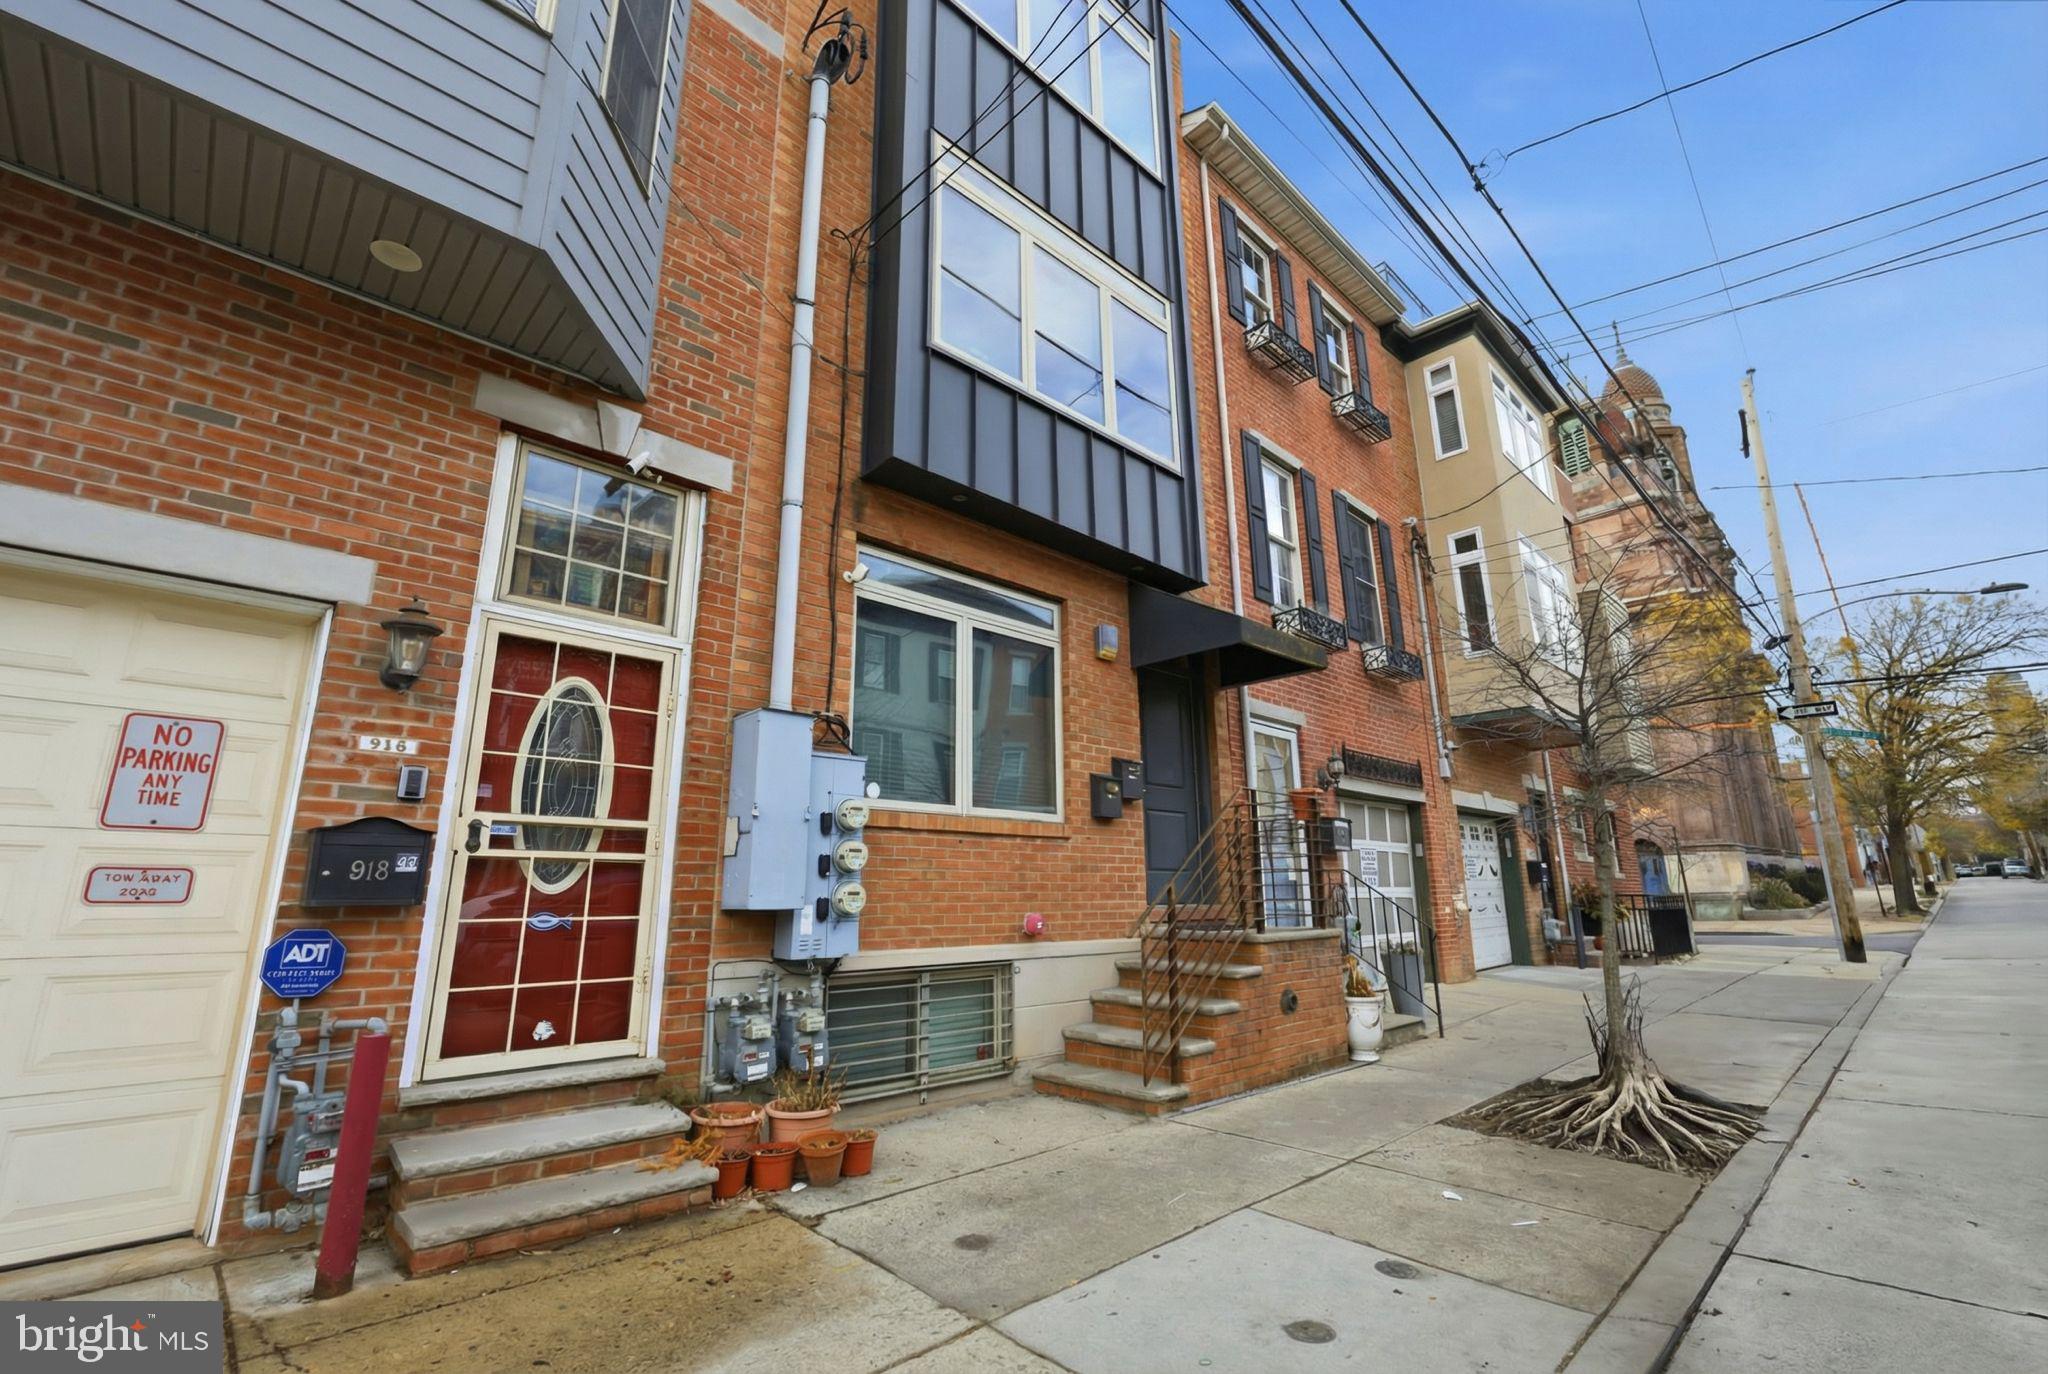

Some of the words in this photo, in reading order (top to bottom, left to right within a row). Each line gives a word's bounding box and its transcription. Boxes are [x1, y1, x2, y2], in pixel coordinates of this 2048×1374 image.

[153, 723, 193, 747] NO
[369, 737, 407, 752] 916
[120, 746, 212, 774] PARKING
[142, 773, 184, 789] ANY
[137, 789, 182, 807] TIME
[105, 873, 135, 882] TOW
[349, 859, 389, 880] 918
[283, 943, 330, 963] ADT
